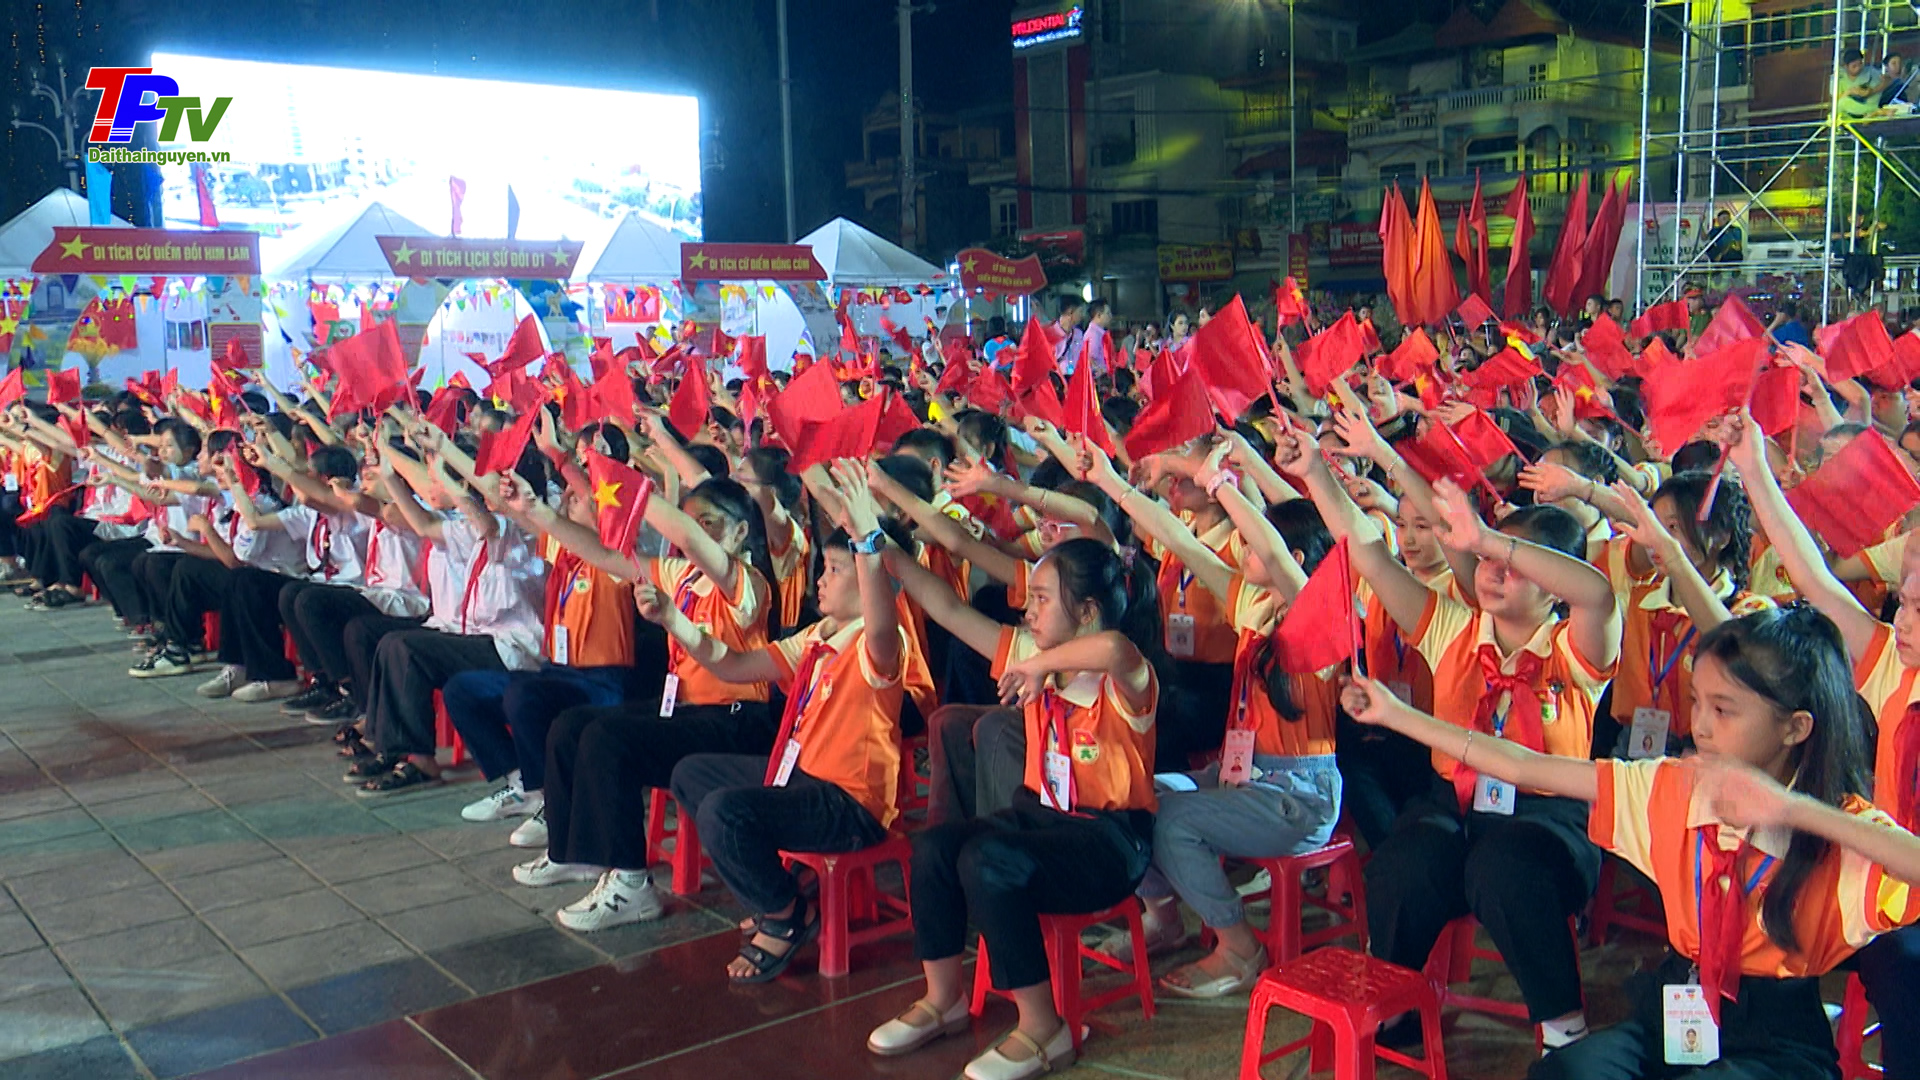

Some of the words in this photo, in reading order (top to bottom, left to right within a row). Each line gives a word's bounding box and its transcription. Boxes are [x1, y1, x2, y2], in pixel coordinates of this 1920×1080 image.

[108, 243, 134, 261] TÍCH
[227, 246, 250, 261] LAM
[420, 249, 433, 267] DI
[435, 247, 462, 267] TÍCH
[465, 250, 490, 270] LỊCH
[720, 256, 737, 271] TÍCH
